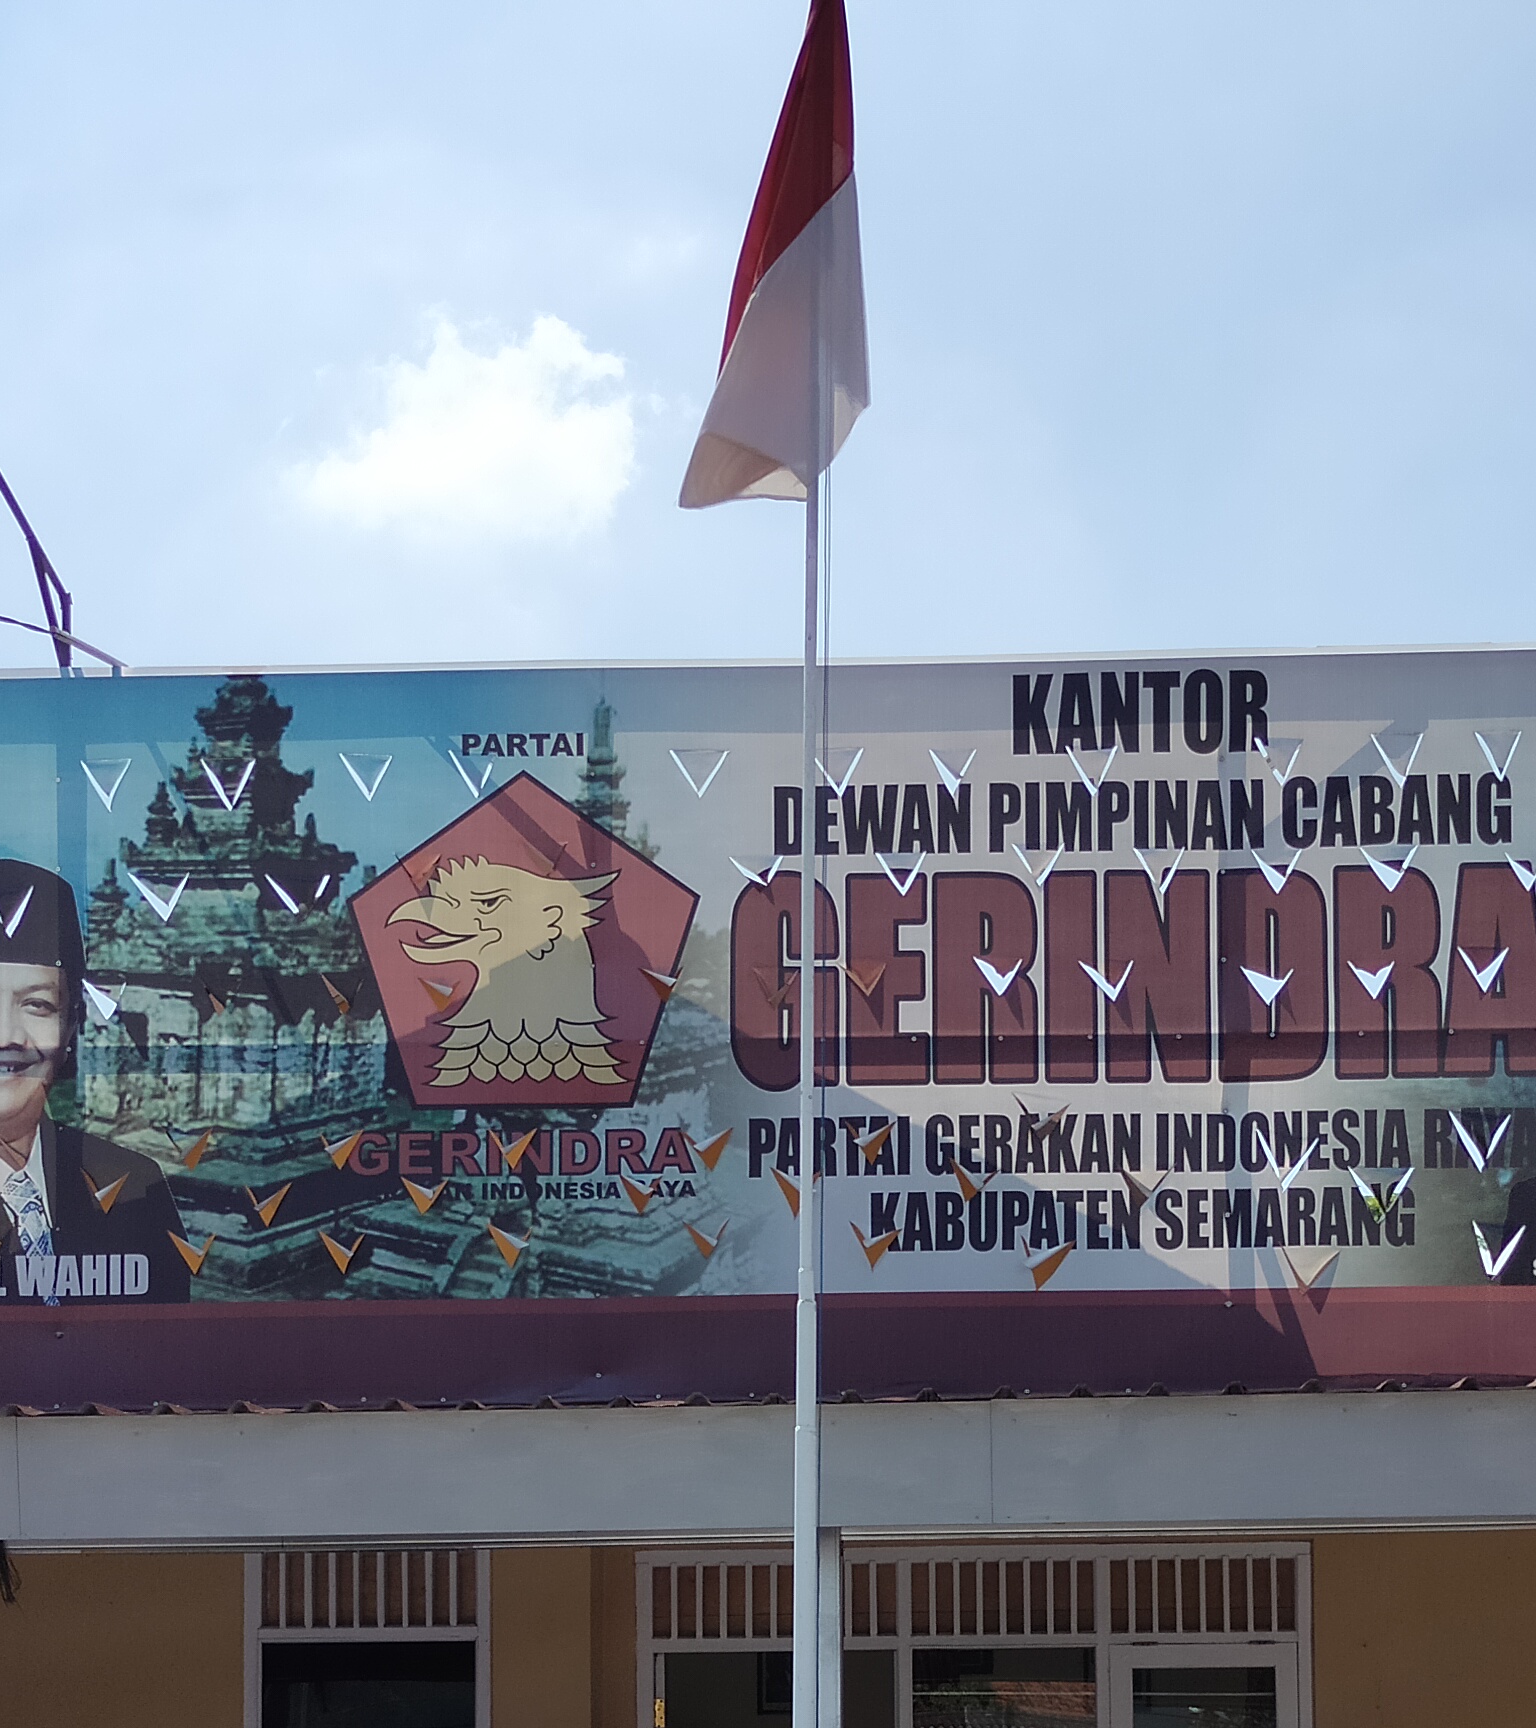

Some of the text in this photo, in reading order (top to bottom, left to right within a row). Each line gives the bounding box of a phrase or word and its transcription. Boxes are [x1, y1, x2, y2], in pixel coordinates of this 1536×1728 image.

[1012, 668, 1268, 755] KANTOR
[461, 732, 585, 759] PARTAI
[774, 770, 1512, 855] DEWAN PIMPINAN CABANG
[348, 1128, 696, 1176] GERINDRA
[748, 1115, 911, 1178] PARTAI
[925, 1111, 1141, 1176] GERAKAN
[1156, 1109, 1411, 1173] INDONESIA
[634, 1180, 696, 1198] AYA
[870, 1181, 1415, 1252] KABUPATEN SEMARANG
[16, 1253, 150, 1298] WAHID
